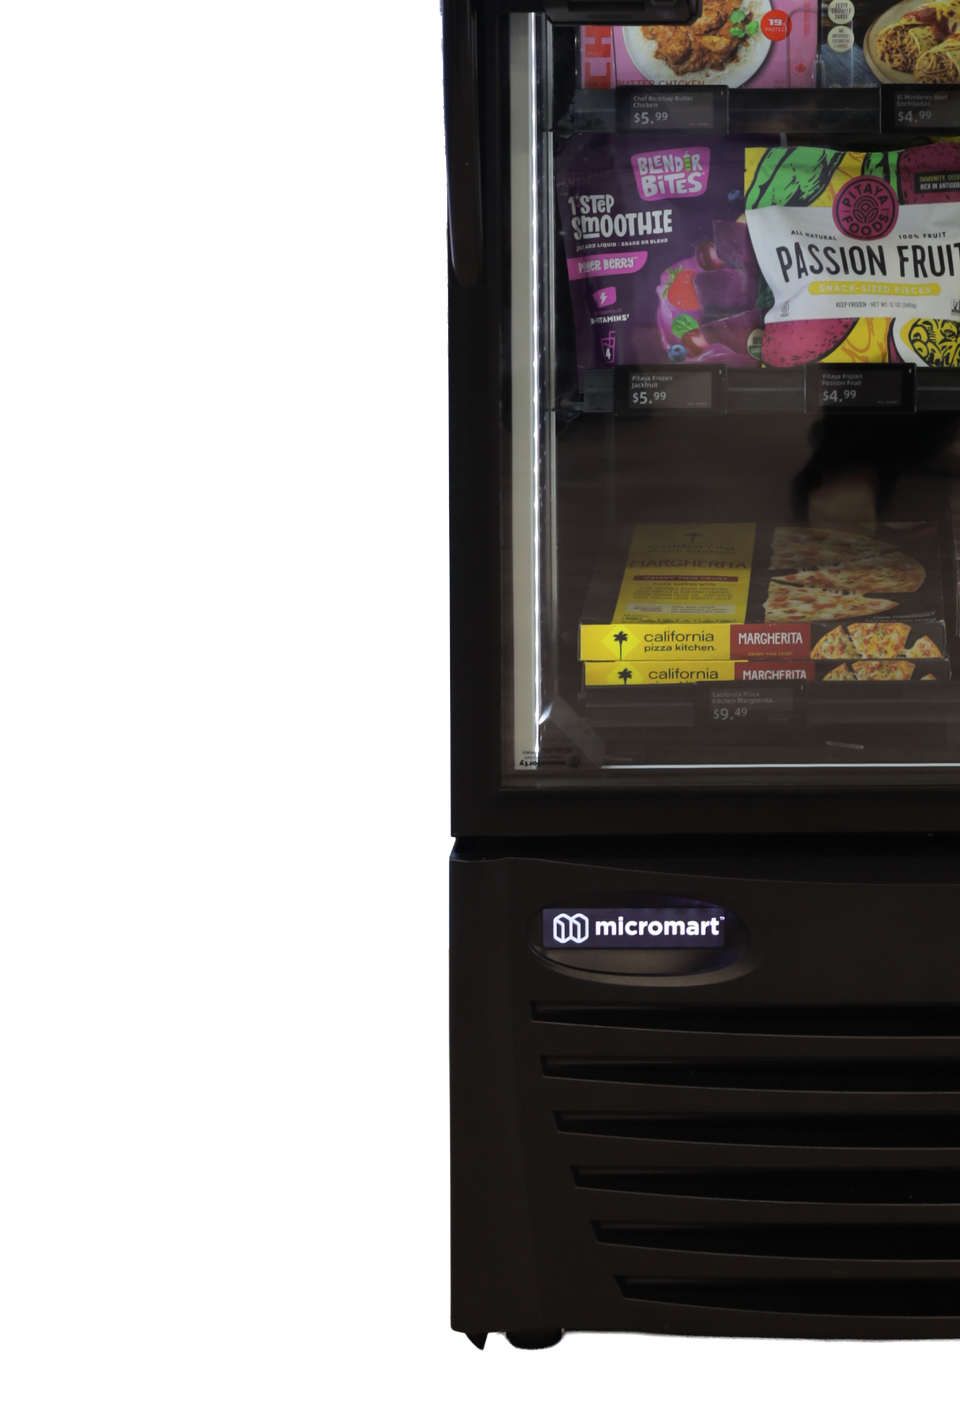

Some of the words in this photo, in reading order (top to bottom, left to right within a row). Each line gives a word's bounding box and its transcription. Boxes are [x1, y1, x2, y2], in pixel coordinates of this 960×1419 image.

[648, 95, 674, 103] Bombay
[634, 111, 668, 125] $5.99
[897, 110, 932, 123] $4.99
[843, 183, 888, 208] PITAYA
[842, 214, 890, 236] FOODS
[805, 232, 837, 241] NATURAL
[923, 231, 947, 239] FRUIT
[776, 242, 888, 283] PASSION
[819, 284, 891, 293] SNACK-SIZED
[894, 286, 931, 294] PIECES
[822, 373, 841, 381] Pitaya
[632, 391, 667, 405] $5.99
[822, 389, 857, 403] $4.99
[629, 559, 748, 569] MARGHERITA
[643, 630, 715, 642] california
[738, 631, 804, 645] MARGHERITA
[648, 668, 719, 680] california
[713, 707, 748, 721] $9.49
[595, 916, 720, 936] micromart
